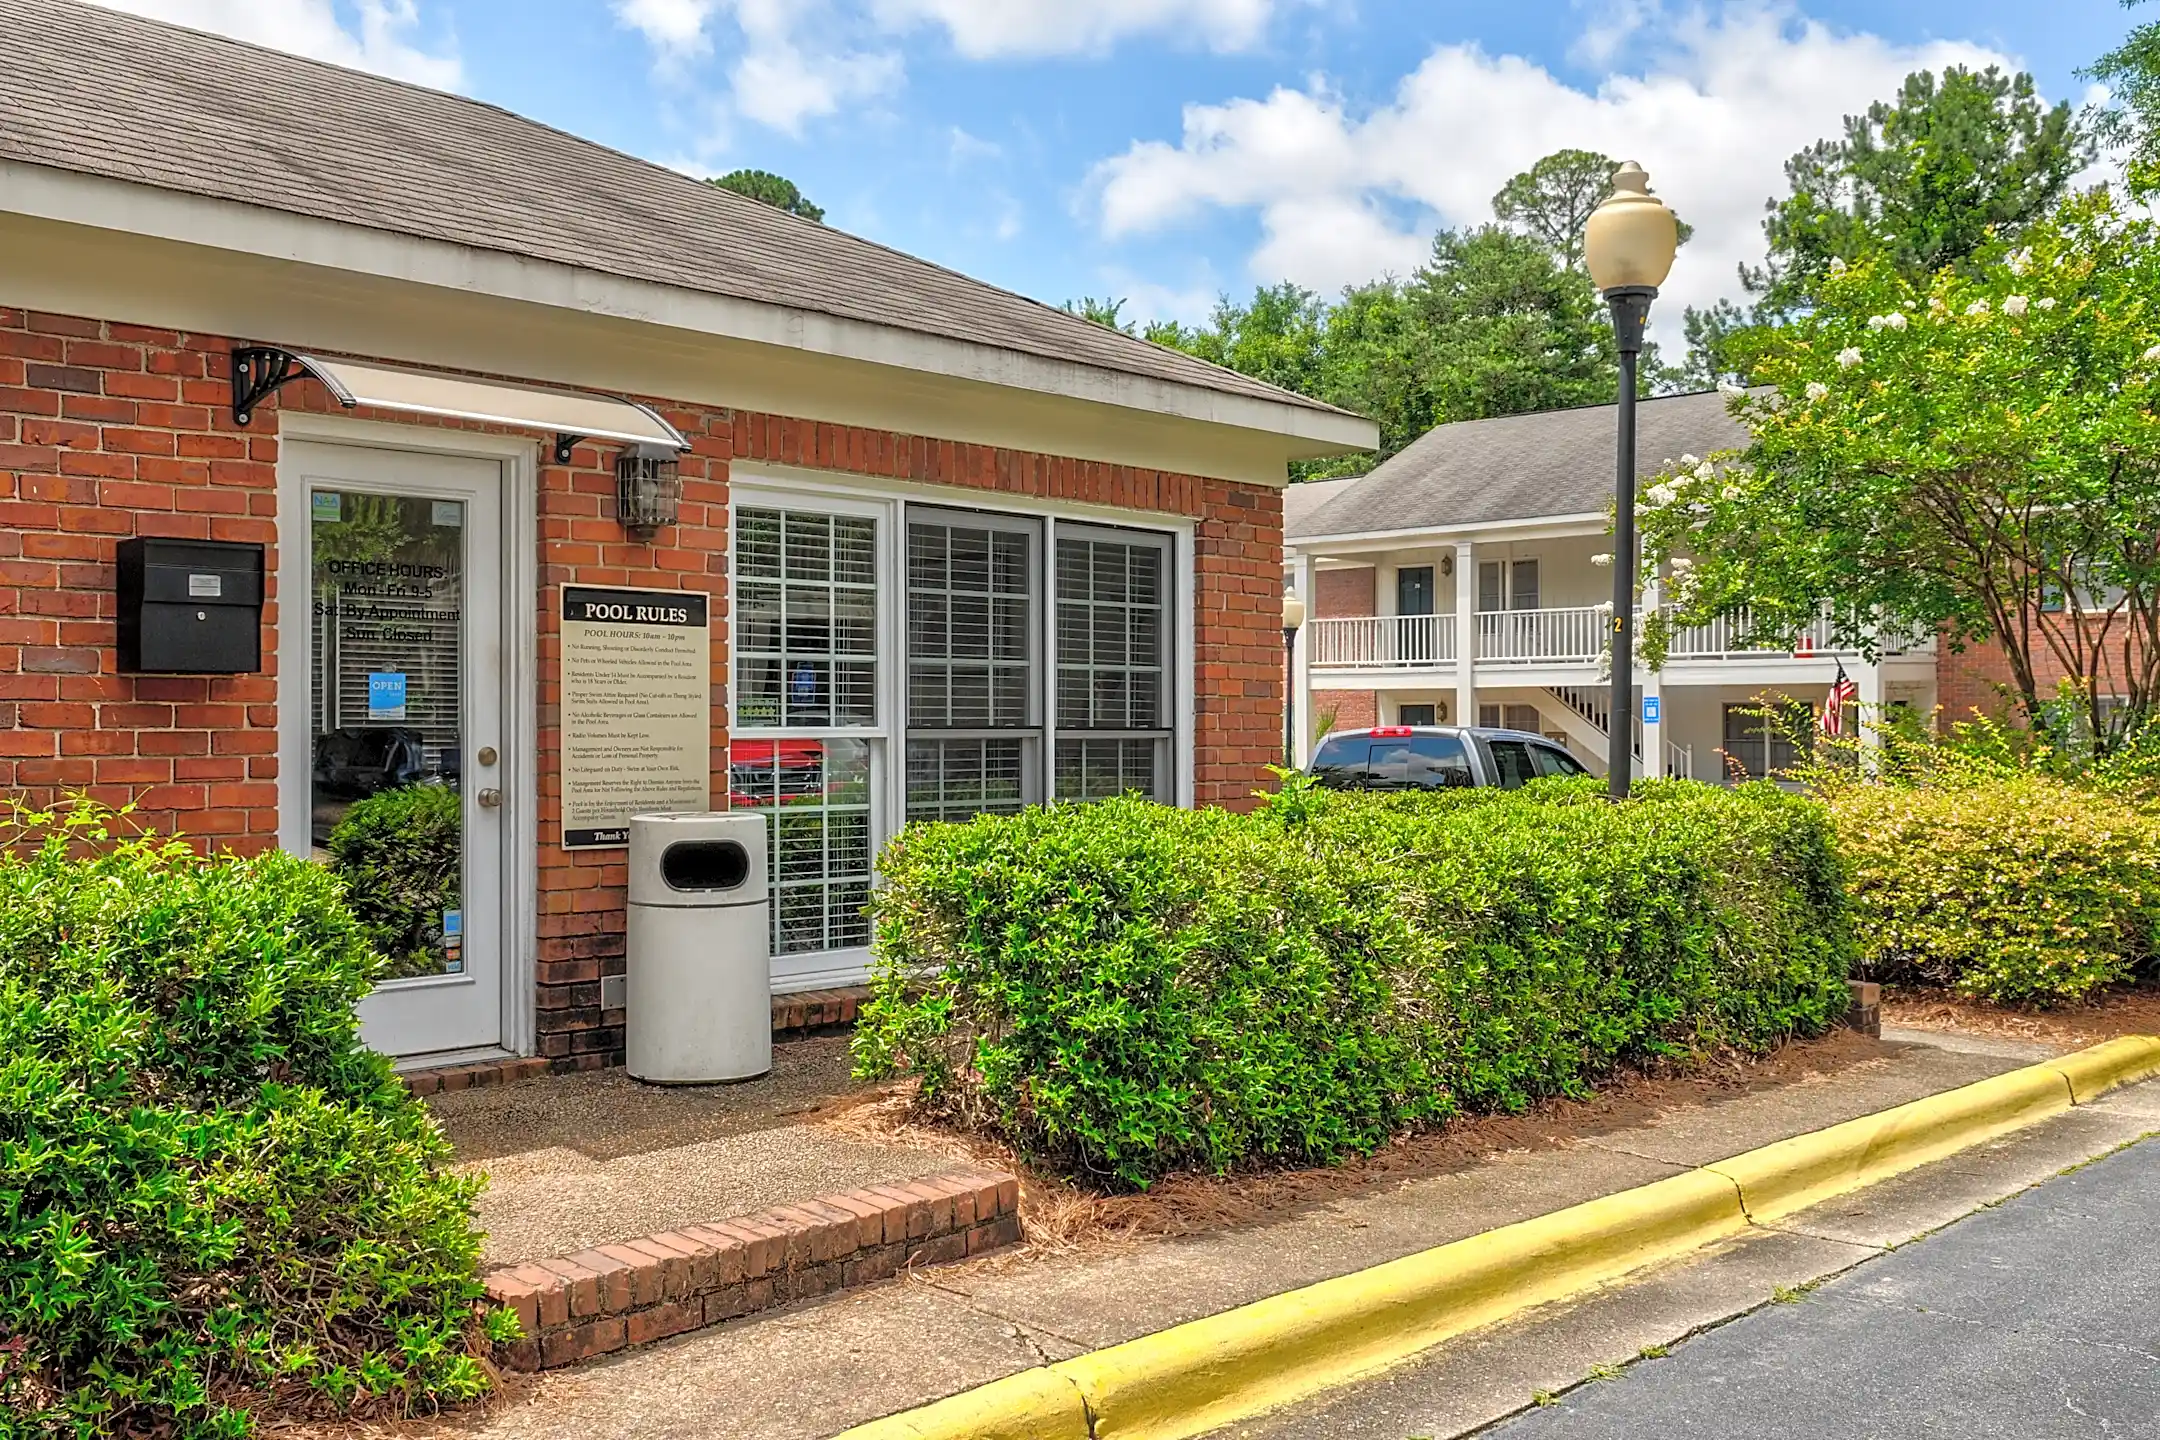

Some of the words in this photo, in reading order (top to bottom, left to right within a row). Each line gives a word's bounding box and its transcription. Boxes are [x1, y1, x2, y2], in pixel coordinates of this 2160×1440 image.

[328, 560, 385, 576] OFFICE
[390, 564, 448, 579] HOURS:
[344, 582, 376, 596] Mon
[411, 586, 432, 598] 9-5
[346, 604, 364, 620] By
[369, 605, 460, 620] Appointment
[585, 602, 632, 620] POOL
[636, 605, 687, 623] RULES
[1614, 618, 1622, 632] 2
[383, 628, 432, 642] Closed
[584, 630, 608, 638] POOL
[610, 630, 640, 639] HOURS:
[668, 634, 685, 642] 10pm
[372, 682, 402, 690] OPEN
[594, 831, 621, 841] Thank
